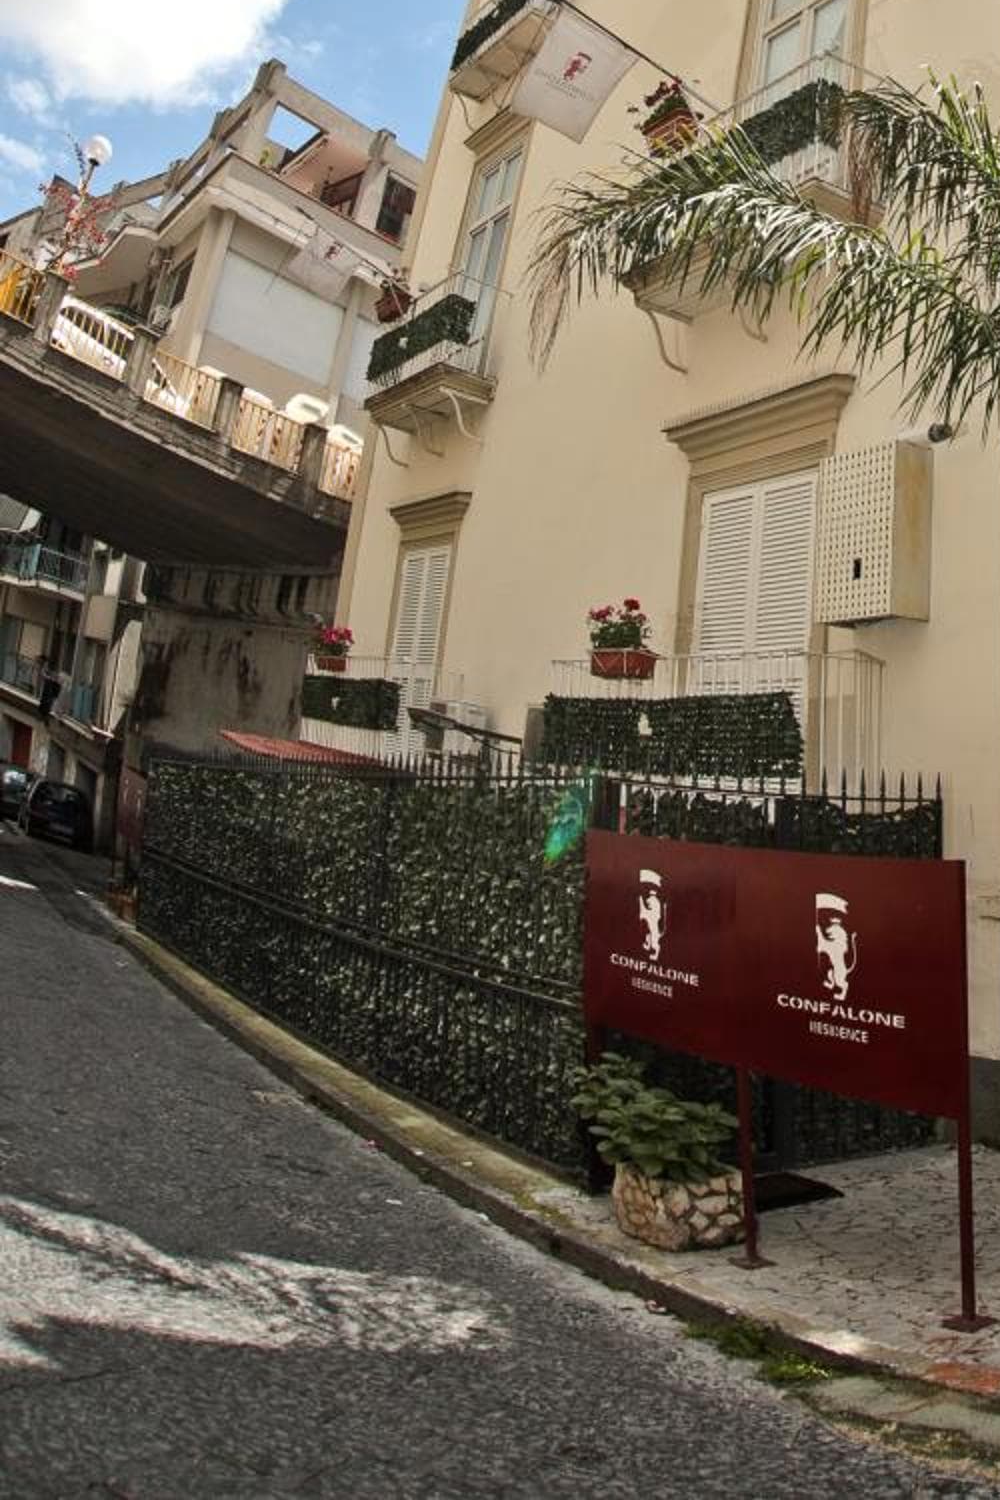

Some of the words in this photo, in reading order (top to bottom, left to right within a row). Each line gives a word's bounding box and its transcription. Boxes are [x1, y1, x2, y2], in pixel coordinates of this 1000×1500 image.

[610, 953, 700, 987] CONFALONE
[777, 993, 906, 1029] CONFALONE
[809, 1020, 869, 1043] RESIDENCE
